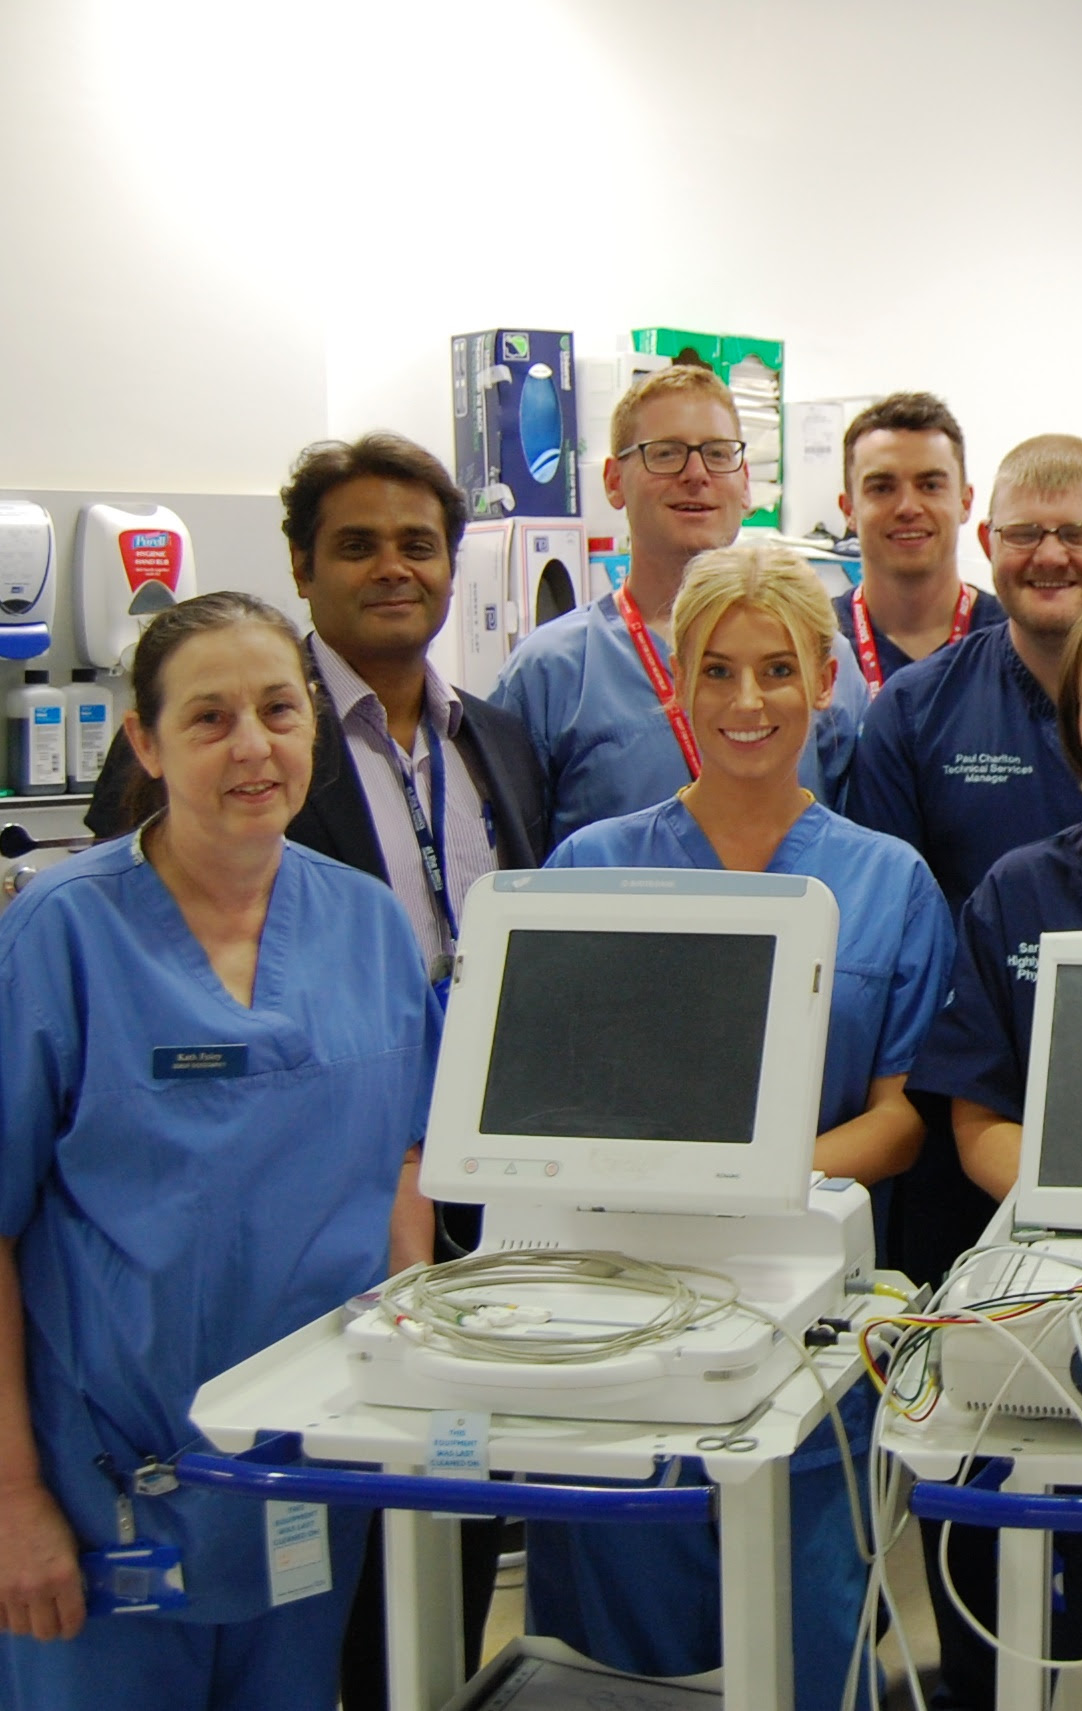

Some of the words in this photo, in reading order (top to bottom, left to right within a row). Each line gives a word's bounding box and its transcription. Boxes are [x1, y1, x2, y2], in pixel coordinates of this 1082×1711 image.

[955, 754, 977, 763] Paul
[943, 764, 988, 774] Technical
[990, 764, 1033, 774] Services
[964, 774, 1008, 784] Manager
